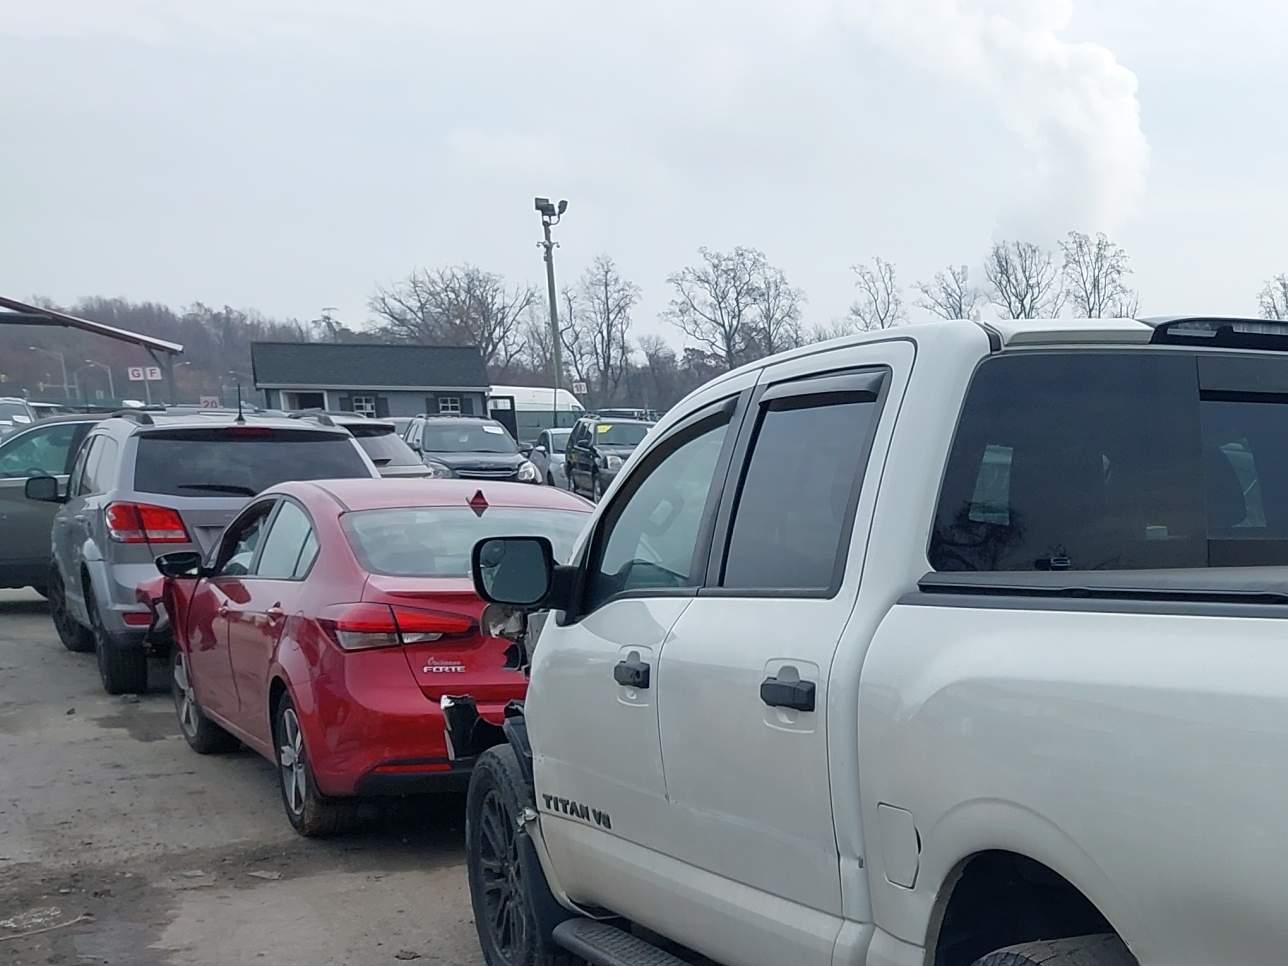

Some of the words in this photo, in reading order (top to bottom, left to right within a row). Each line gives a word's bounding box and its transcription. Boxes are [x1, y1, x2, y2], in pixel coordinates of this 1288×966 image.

[131, 368, 142, 379] G
[149, 368, 158, 379] F
[423, 665, 466, 673] FORTE
[542, 792, 591, 822] TITAN
